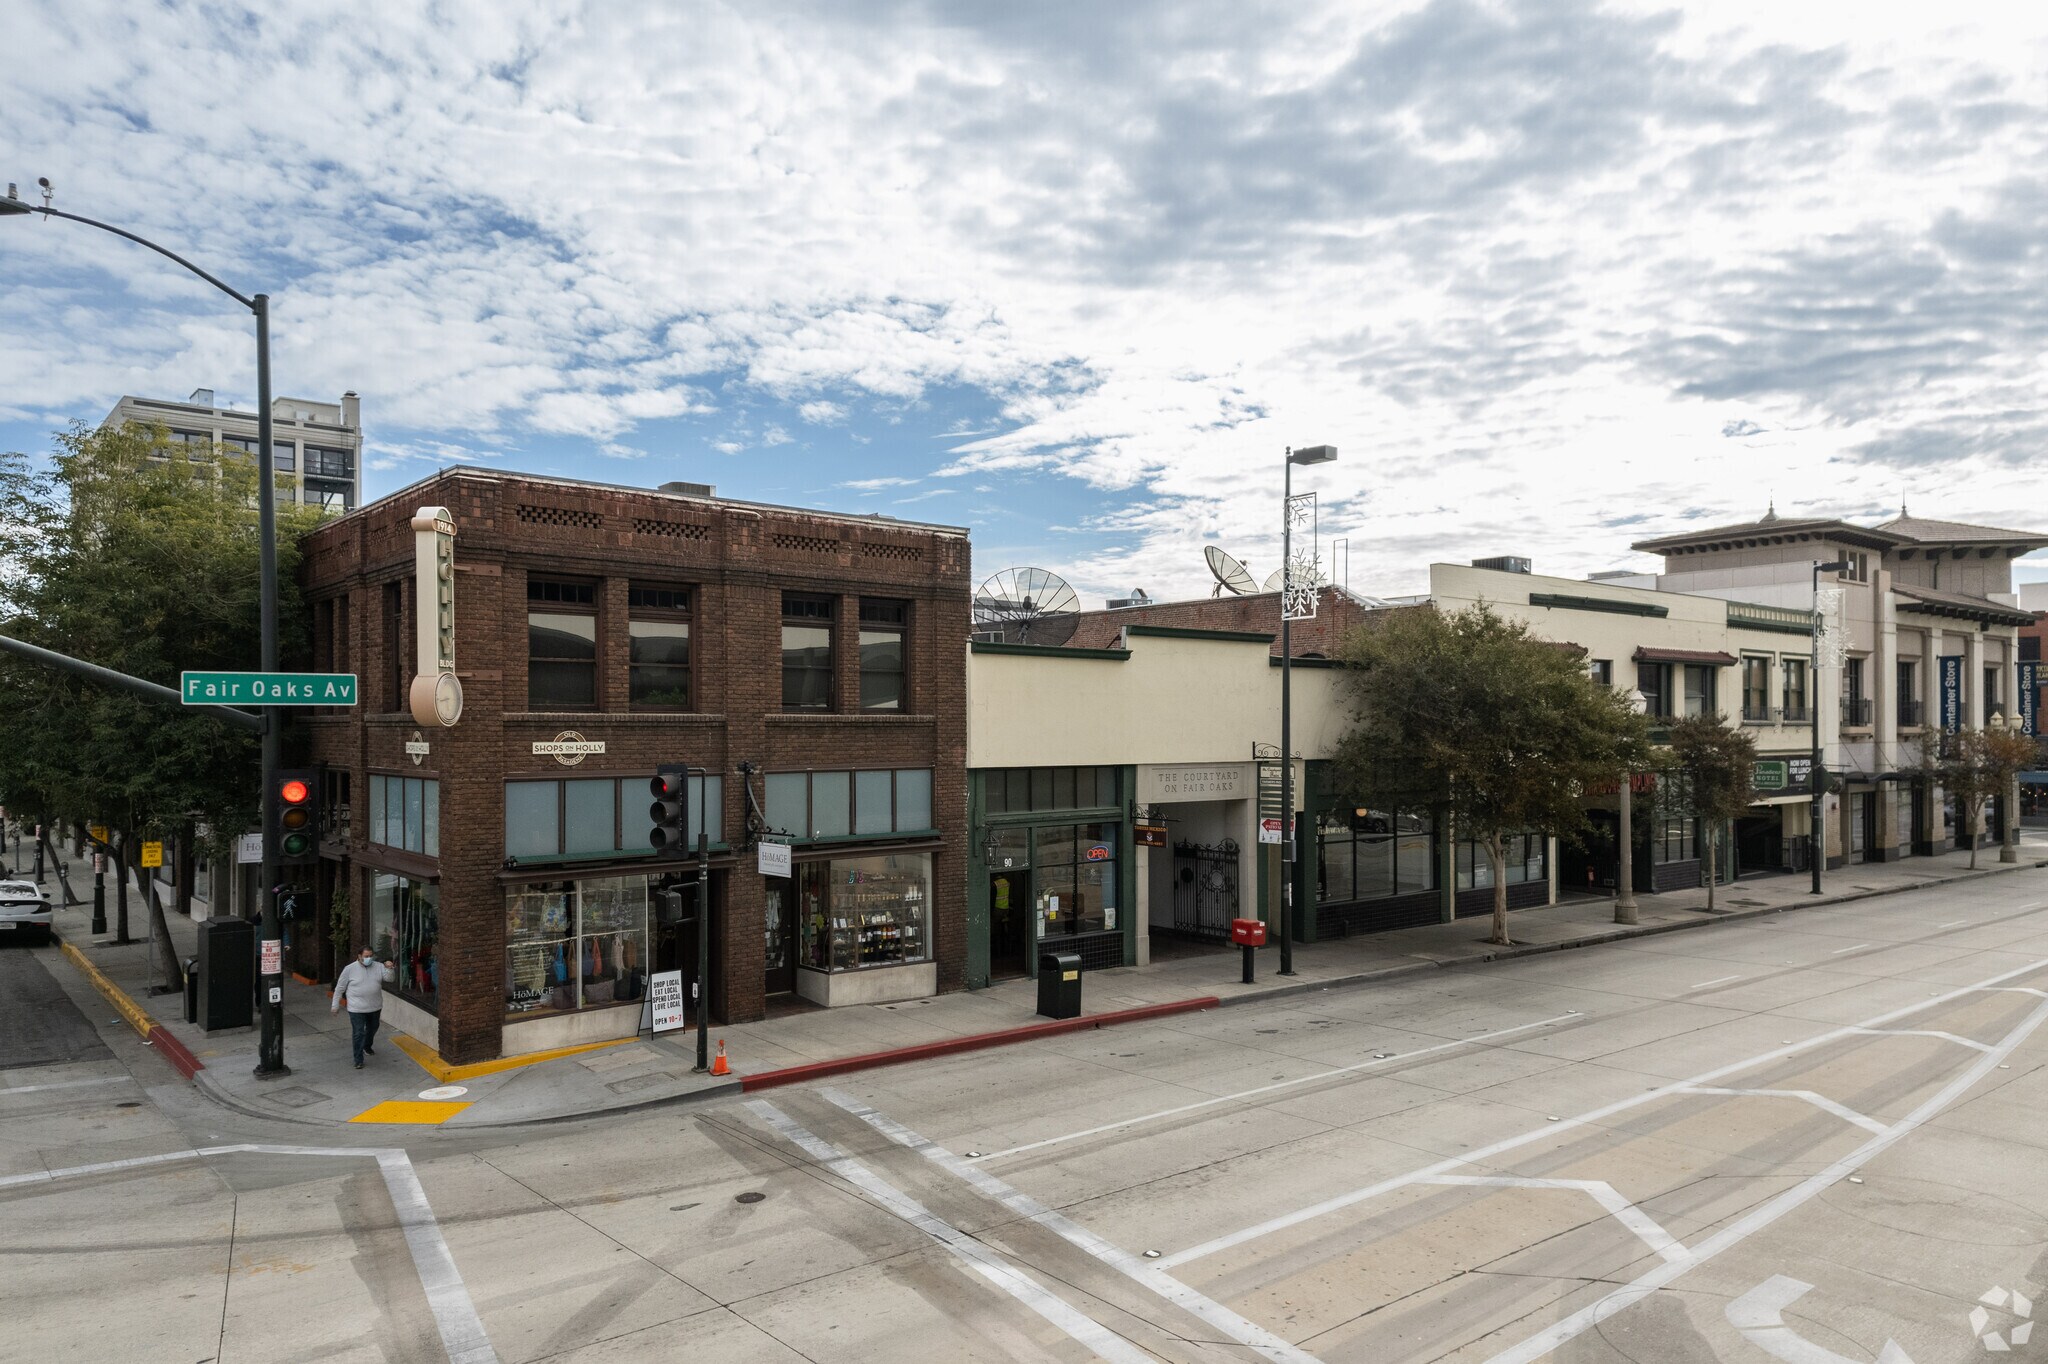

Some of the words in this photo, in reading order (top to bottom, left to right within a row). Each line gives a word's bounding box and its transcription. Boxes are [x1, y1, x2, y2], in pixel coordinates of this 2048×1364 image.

[437, 520, 451, 533] 1914
[438, 538, 455, 655] HOLLY
[439, 659, 454, 668] BLDG
[1945, 661, 1956, 687] Store
[2021, 665, 2031, 690] Store
[188, 680, 240, 697] Fair
[252, 681, 314, 698] Oaks
[324, 681, 350, 698] Av
[1946, 688, 1956, 736] Container
[2022, 691, 2032, 734] Container
[575, 744, 604, 752] HOLLY
[1800, 759, 1811, 767] OPEN
[1158, 773, 1178, 782] THE
[1183, 771, 1239, 782] COURTYARD
[1164, 784, 1178, 793] ON
[1183, 783, 1205, 792] FAIR
[1209, 781, 1233, 791] OAKS
[1087, 848, 1109, 859] OPEN
[1004, 858, 1012, 867] 90
[664, 986, 678, 994] LOCAL
[667, 993, 681, 1001] LOCAL
[667, 1000, 680, 1008] LOCAL
